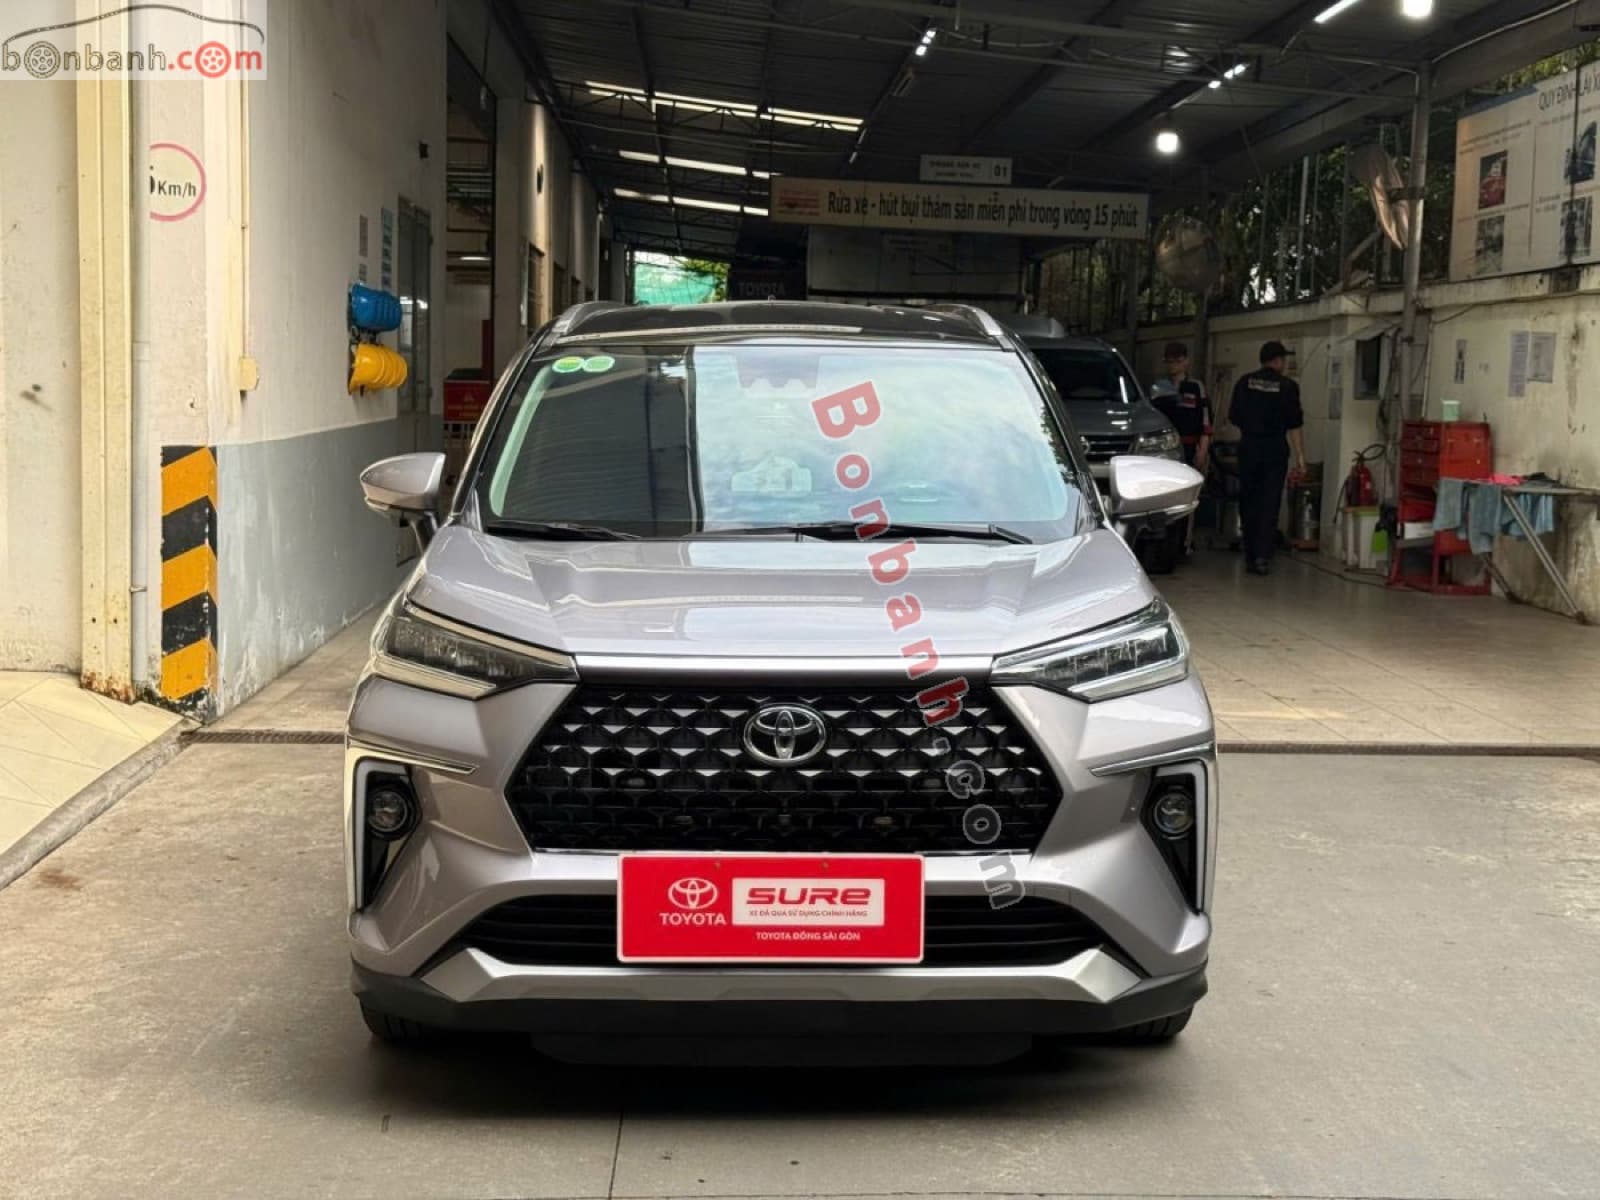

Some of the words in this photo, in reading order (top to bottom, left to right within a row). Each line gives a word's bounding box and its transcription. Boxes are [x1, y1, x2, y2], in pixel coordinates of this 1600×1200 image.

[994, 164, 1008, 178] 01
[158, 180, 197, 198] Km/h
[854, 198, 869, 215] xe
[901, 193, 921, 224] bụi
[1029, 201, 1061, 229] trong
[1094, 203, 1109, 226] 15
[1110, 203, 1139, 231] phút
[659, 912, 727, 926] TOYOTA
[756, 932, 792, 941] TOYOTA
